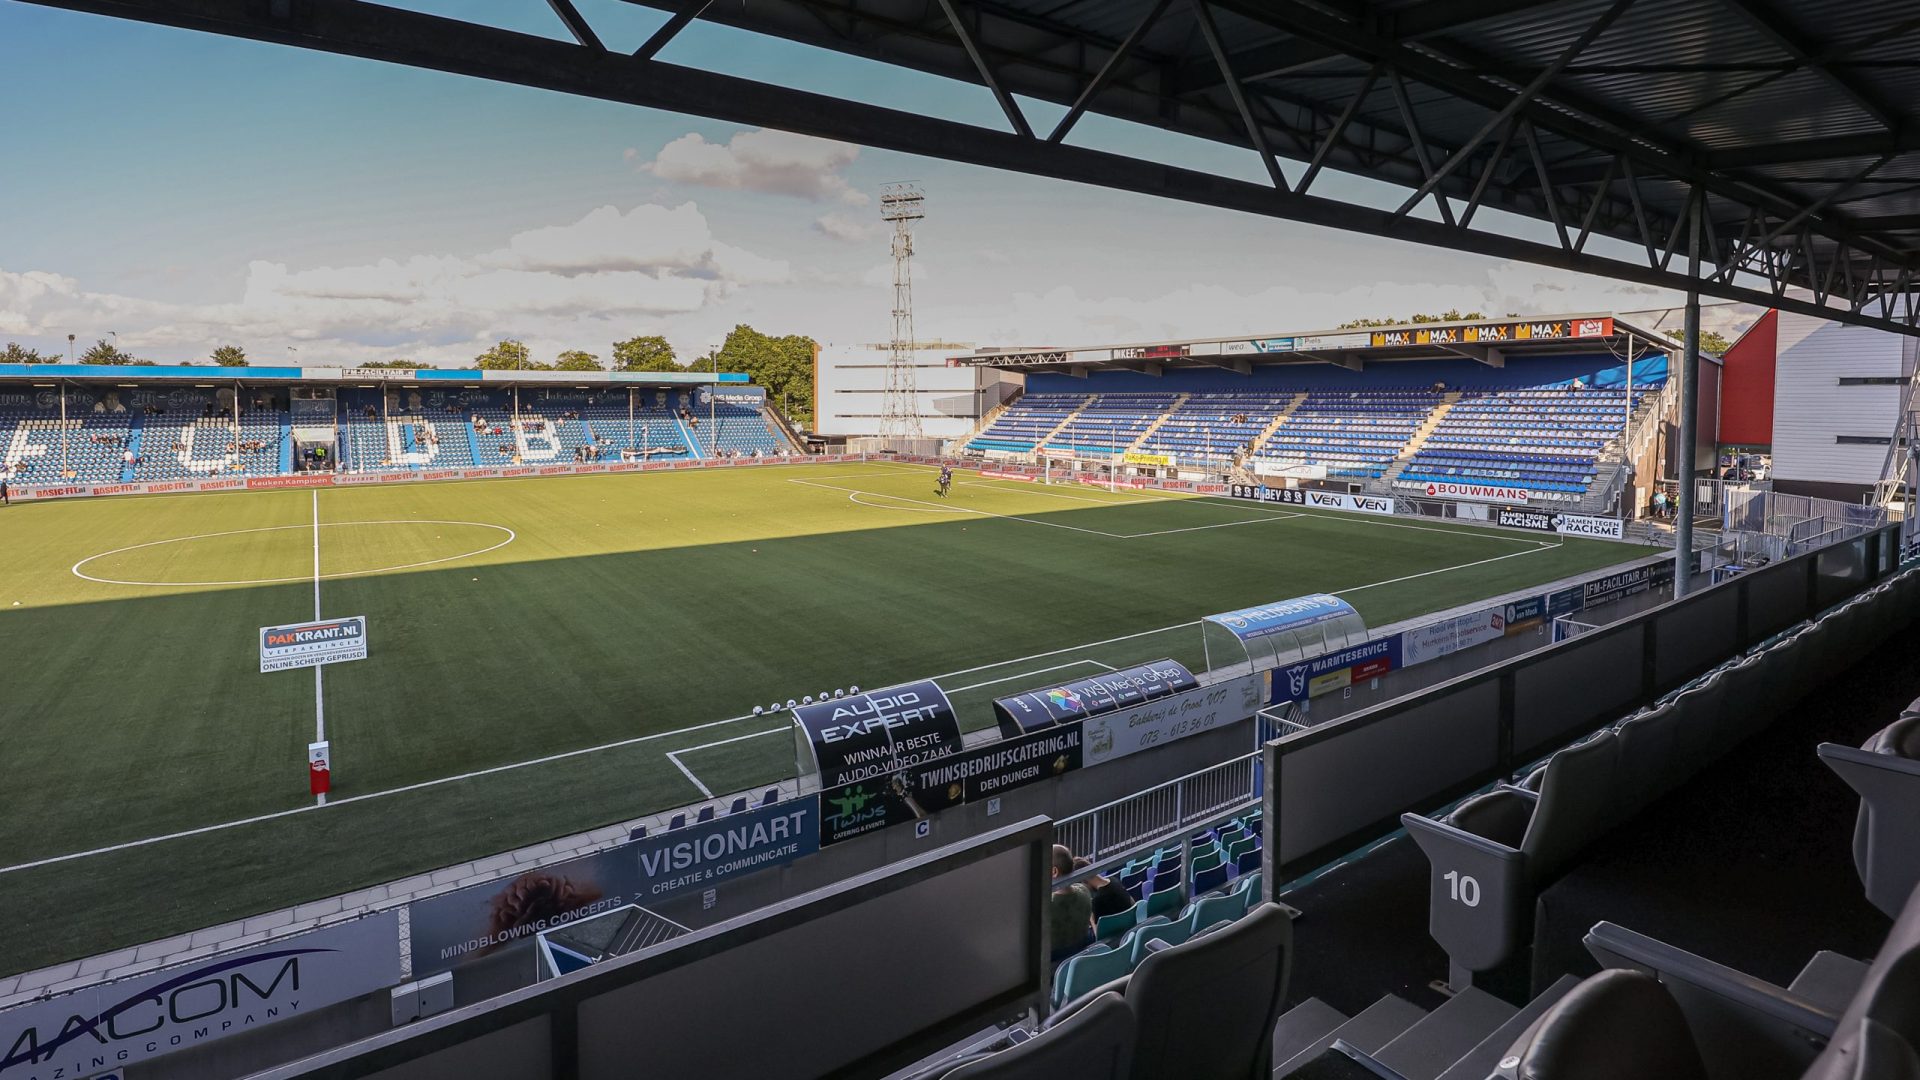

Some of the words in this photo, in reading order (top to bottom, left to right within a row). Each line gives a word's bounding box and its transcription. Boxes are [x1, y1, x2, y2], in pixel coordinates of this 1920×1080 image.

[1385, 331, 1410, 343] MAX
[1430, 329, 1457, 342] MAX
[1479, 326, 1507, 340] MAX
[1532, 323, 1562, 338] MAX
[251, 478, 283, 487] Keuken
[285, 476, 328, 486] Kampioen
[1438, 483, 1528, 499] BOUWMANS
[1253, 487, 1283, 502] RBEY
[1310, 492, 1342, 507] VEN
[1353, 496, 1387, 512] VEN
[1500, 510, 1524, 519] SAMEN
[1524, 513, 1549, 522] TEGEN
[1500, 516, 1549, 530] RACISME
[1566, 517, 1593, 526] SAMEN
[1594, 519, 1620, 528] TEGEN
[1565, 523, 1619, 536] RACISME
[1585, 570, 1641, 597] IFM-FACILITAIR
[268, 625, 359, 646] PAKKRANT.NL
[268, 640, 360, 656] VERPAKKINGEN
[1312, 641, 1388, 673] WARMTESERVICE
[263, 661, 294, 671] ONLINE
[295, 656, 325, 667] SCHERP
[327, 651, 365, 662] GEPRIJSD!
[1078, 684, 1105, 700] WS
[1104, 676, 1145, 693] Media
[1142, 667, 1182, 683] Groep
[832, 692, 920, 721] AUDIO
[820, 704, 939, 744] EXPERT
[1129, 708, 1167, 730] Bakkerij
[1139, 731, 1161, 746] 073
[1170, 723, 1188, 737] 613
[1189, 718, 1202, 732] 56
[1203, 711, 1216, 727] 08
[843, 741, 905, 766] WINNAAR
[907, 732, 942, 750] BESTE
[837, 754, 919, 785] AUDIO-VIDEO
[921, 744, 953, 763] ZAAK
[921, 730, 1081, 790] TWINSBEDRIJFSCATERING.NL
[980, 777, 1000, 792] DEN
[1001, 764, 1040, 787] DUNGEN
[833, 826, 860, 840] CATERING
[864, 819, 886, 831] EVENTS
[917, 822, 928, 834] C
[640, 809, 808, 879] VISIONART
[651, 871, 702, 895] CREATIE
[704, 867, 713, 879] &
[715, 843, 799, 875] COMMUNICATIE
[1443, 868, 1481, 908] 10
[440, 919, 547, 960] MINDBLOWING
[549, 896, 622, 928] CONCEPTS
[146, 1000, 302, 1053] COMPANY
